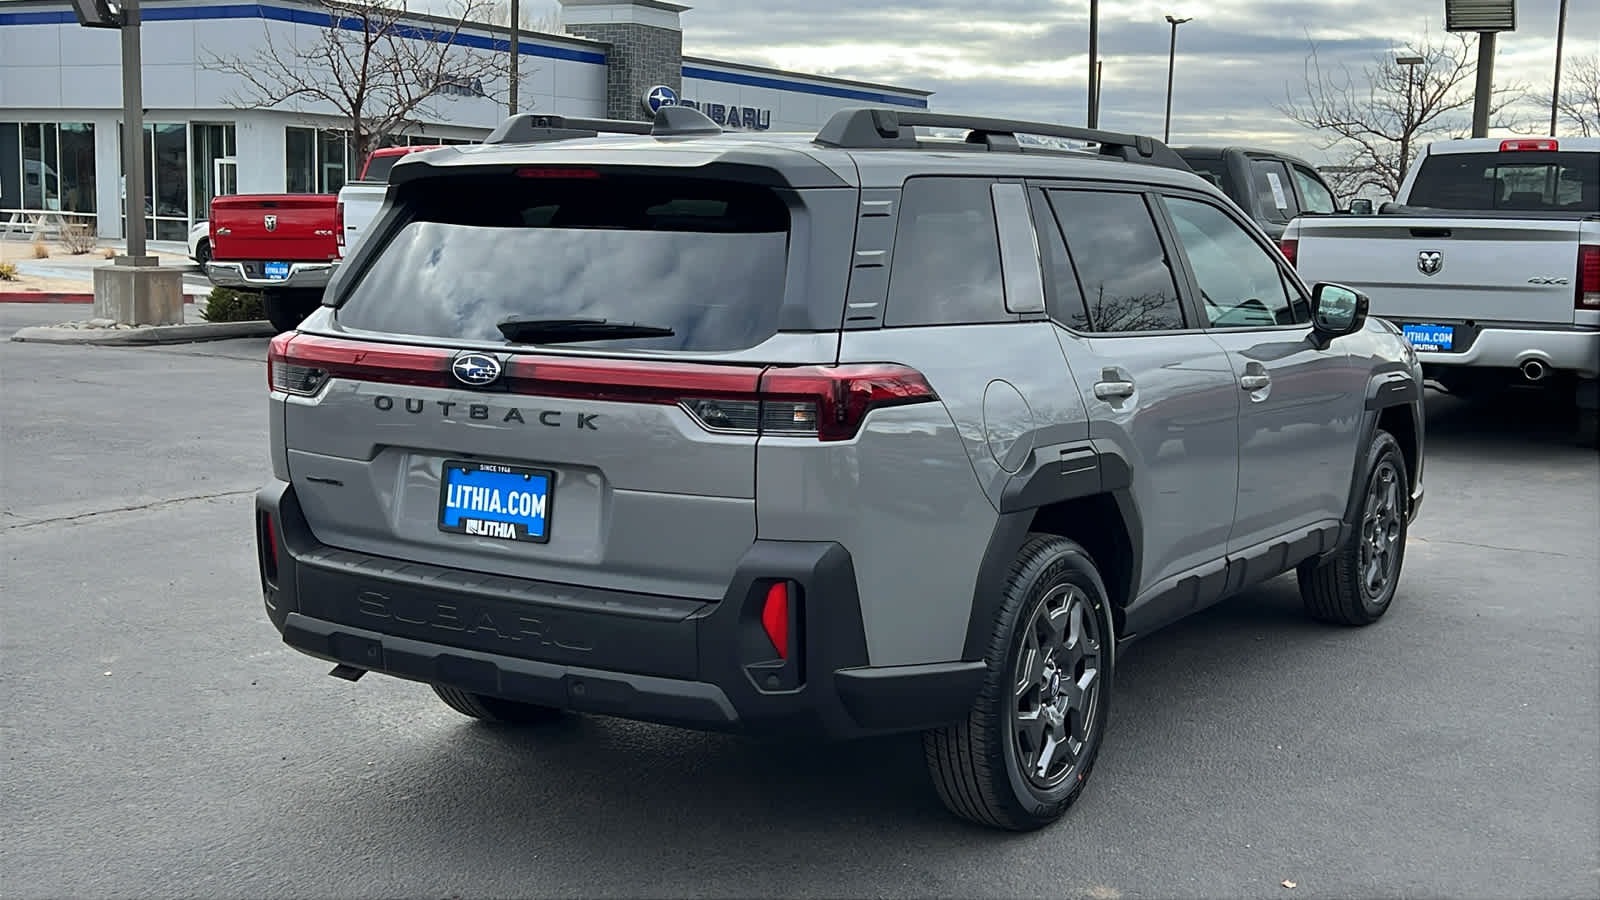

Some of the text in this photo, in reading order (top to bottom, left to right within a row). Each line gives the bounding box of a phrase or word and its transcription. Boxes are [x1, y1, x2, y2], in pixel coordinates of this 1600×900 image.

[374, 395, 600, 431] OUTBACK
[480, 464, 497, 472] SINCE
[447, 484, 547, 519] LITHIA.COM
[477, 519, 517, 539] LITHIA
